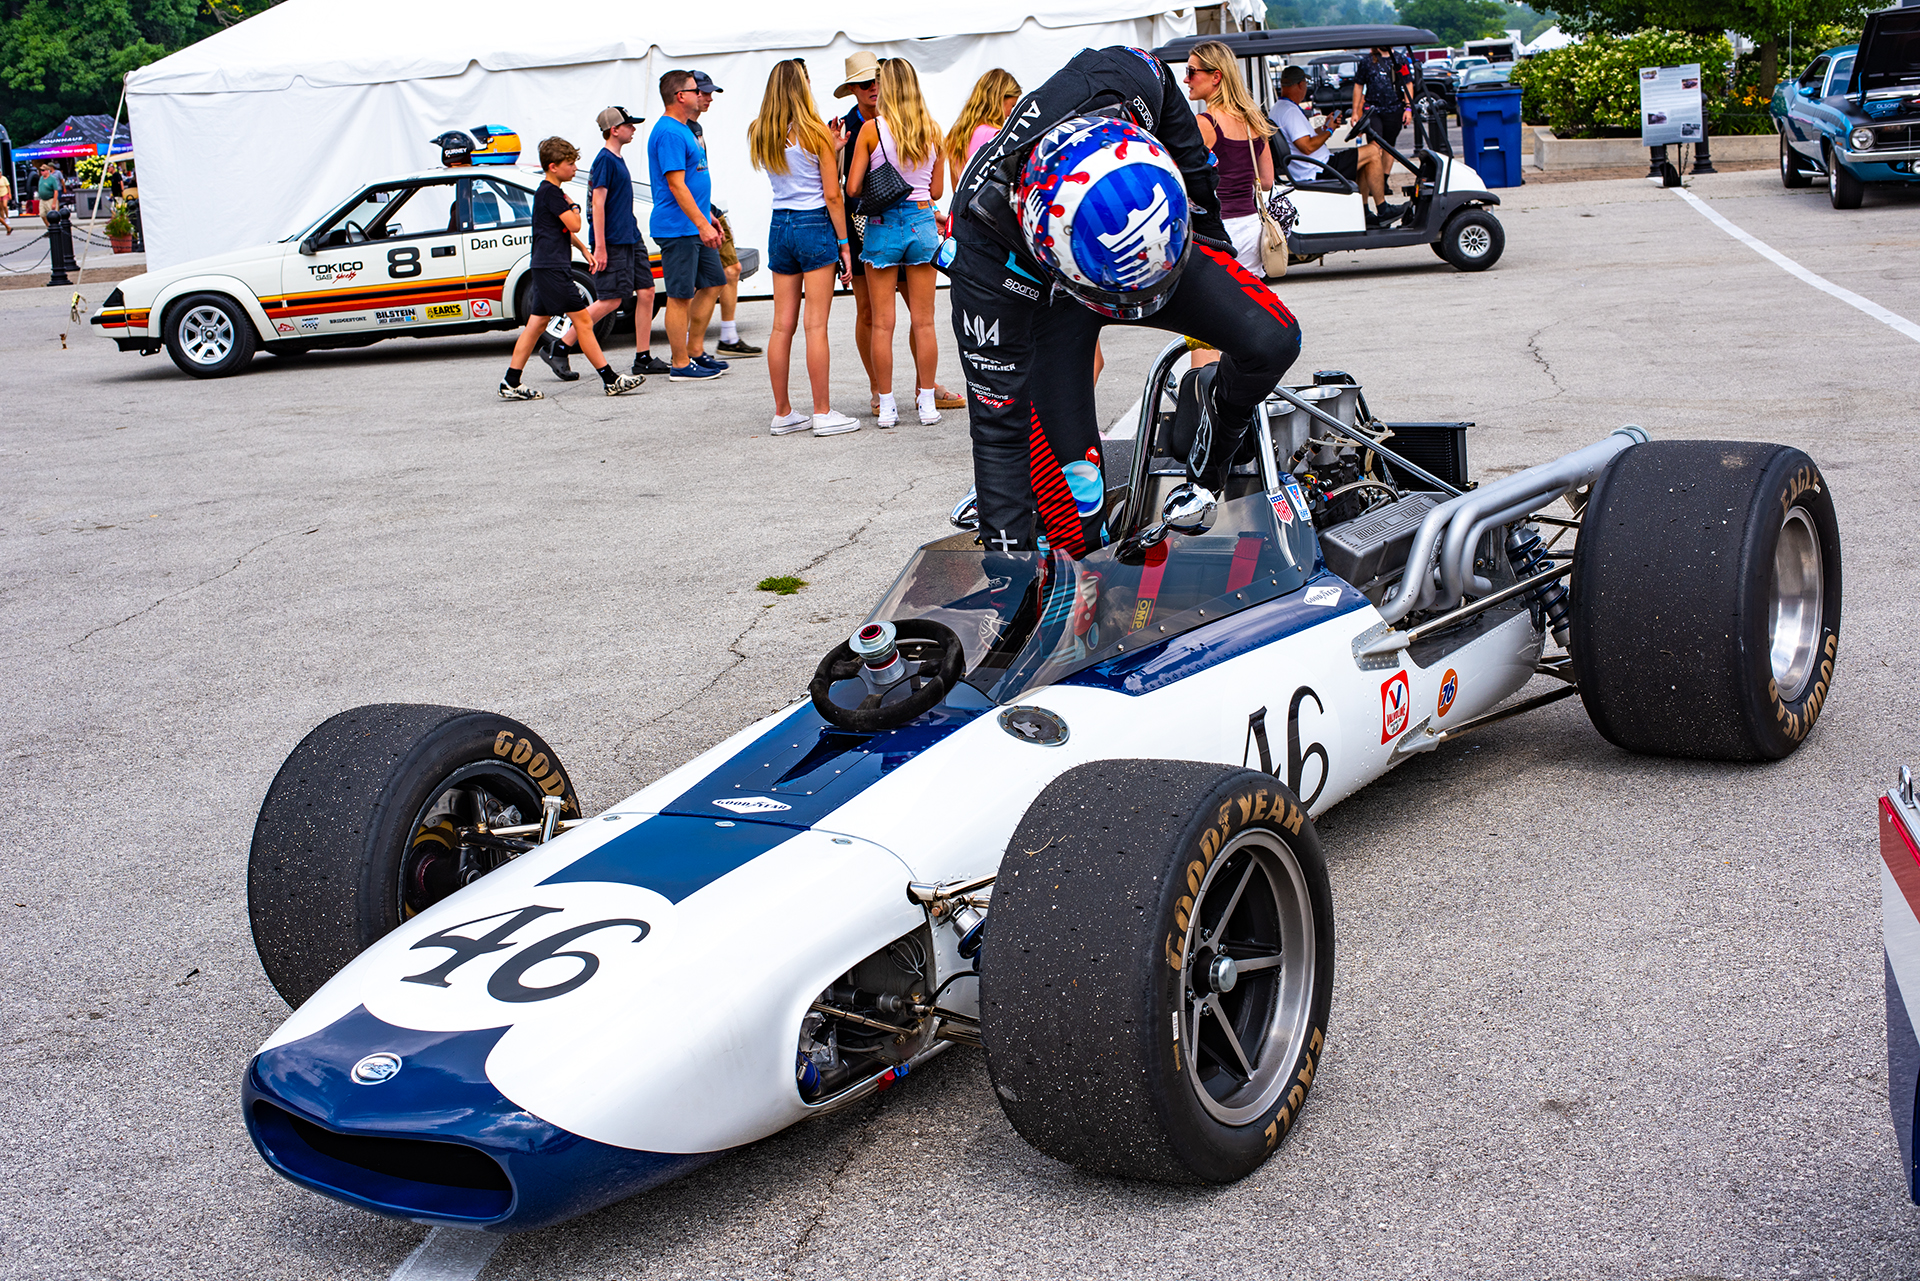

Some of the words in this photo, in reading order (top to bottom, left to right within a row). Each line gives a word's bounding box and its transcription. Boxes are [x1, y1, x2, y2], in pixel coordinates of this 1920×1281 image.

[1133, 98, 1154, 131] sparco
[471, 237, 498, 250] Dan
[308, 261, 363, 275] TOKICO
[387, 246, 422, 279] 8
[1004, 278, 1040, 299] sparco
[376, 309, 415, 319] BILSTEIN
[433, 304, 462, 315] EARL'S
[1135, 600, 1149, 629] OMP
[1439, 675, 1456, 709] 76
[717, 800, 788, 810] GOODYEAR
[400, 904, 651, 1003] 46
[1264, 1025, 1325, 1149] EAGLE
